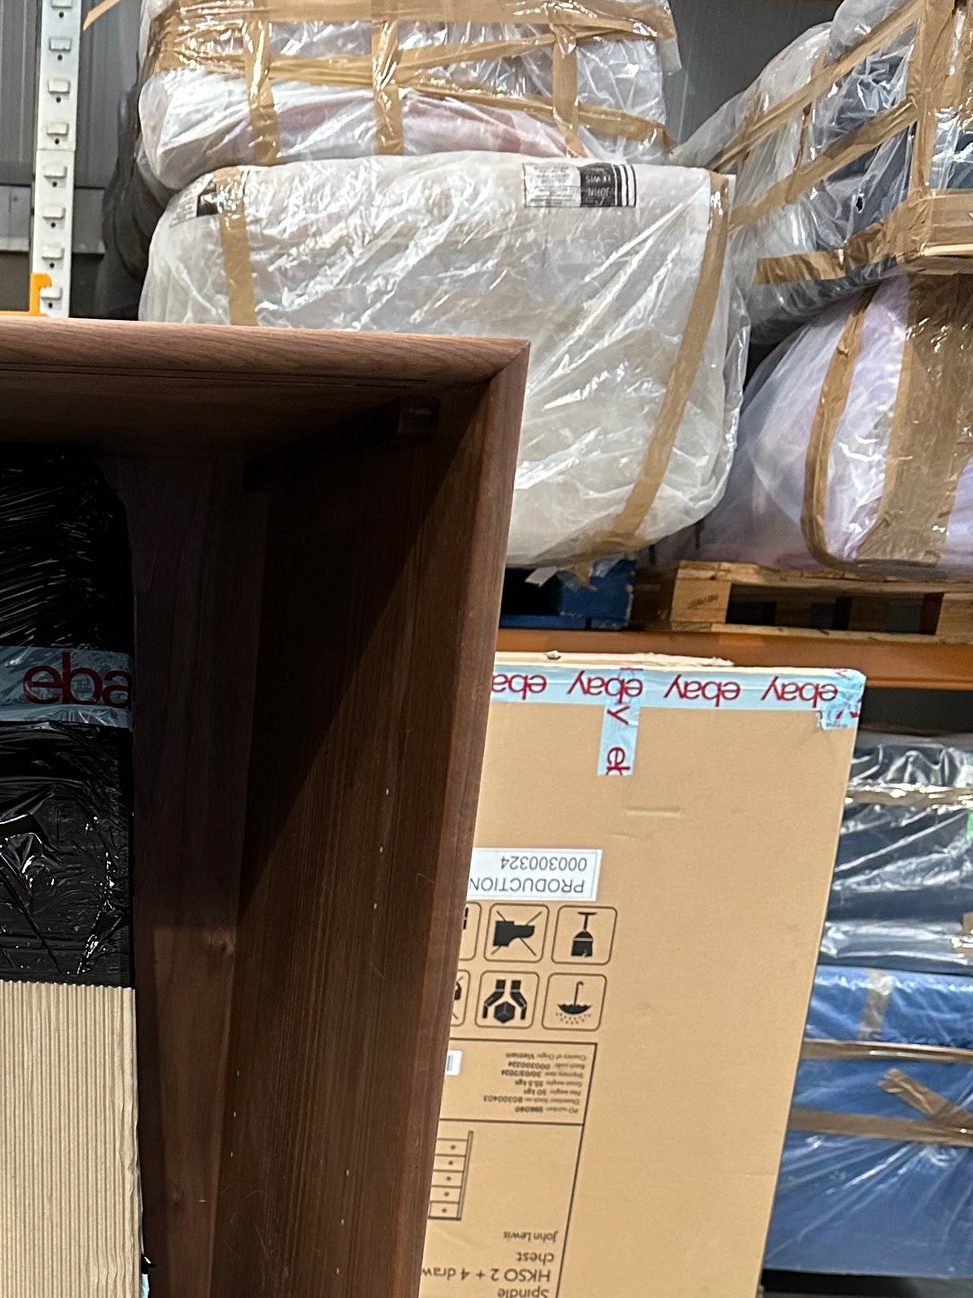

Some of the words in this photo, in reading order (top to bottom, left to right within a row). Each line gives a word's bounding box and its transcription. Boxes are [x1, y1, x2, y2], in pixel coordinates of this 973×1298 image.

[567, 670, 643, 704] ebay
[664, 674, 741, 707] ebay
[762, 676, 838, 708] ebay
[500, 855, 588, 872] 000300324
[469, 876, 585, 893] PRODUCTION
[502, 1231, 531, 1241] Lewis
[533, 1230, 559, 1243] John
[515, 1251, 555, 1266] chest
[460, 1267, 470, 1281] 4
[475, 1269, 486, 1280] +
[490, 1268, 500, 1281] 2
[504, 1268, 551, 1282] HKSO
